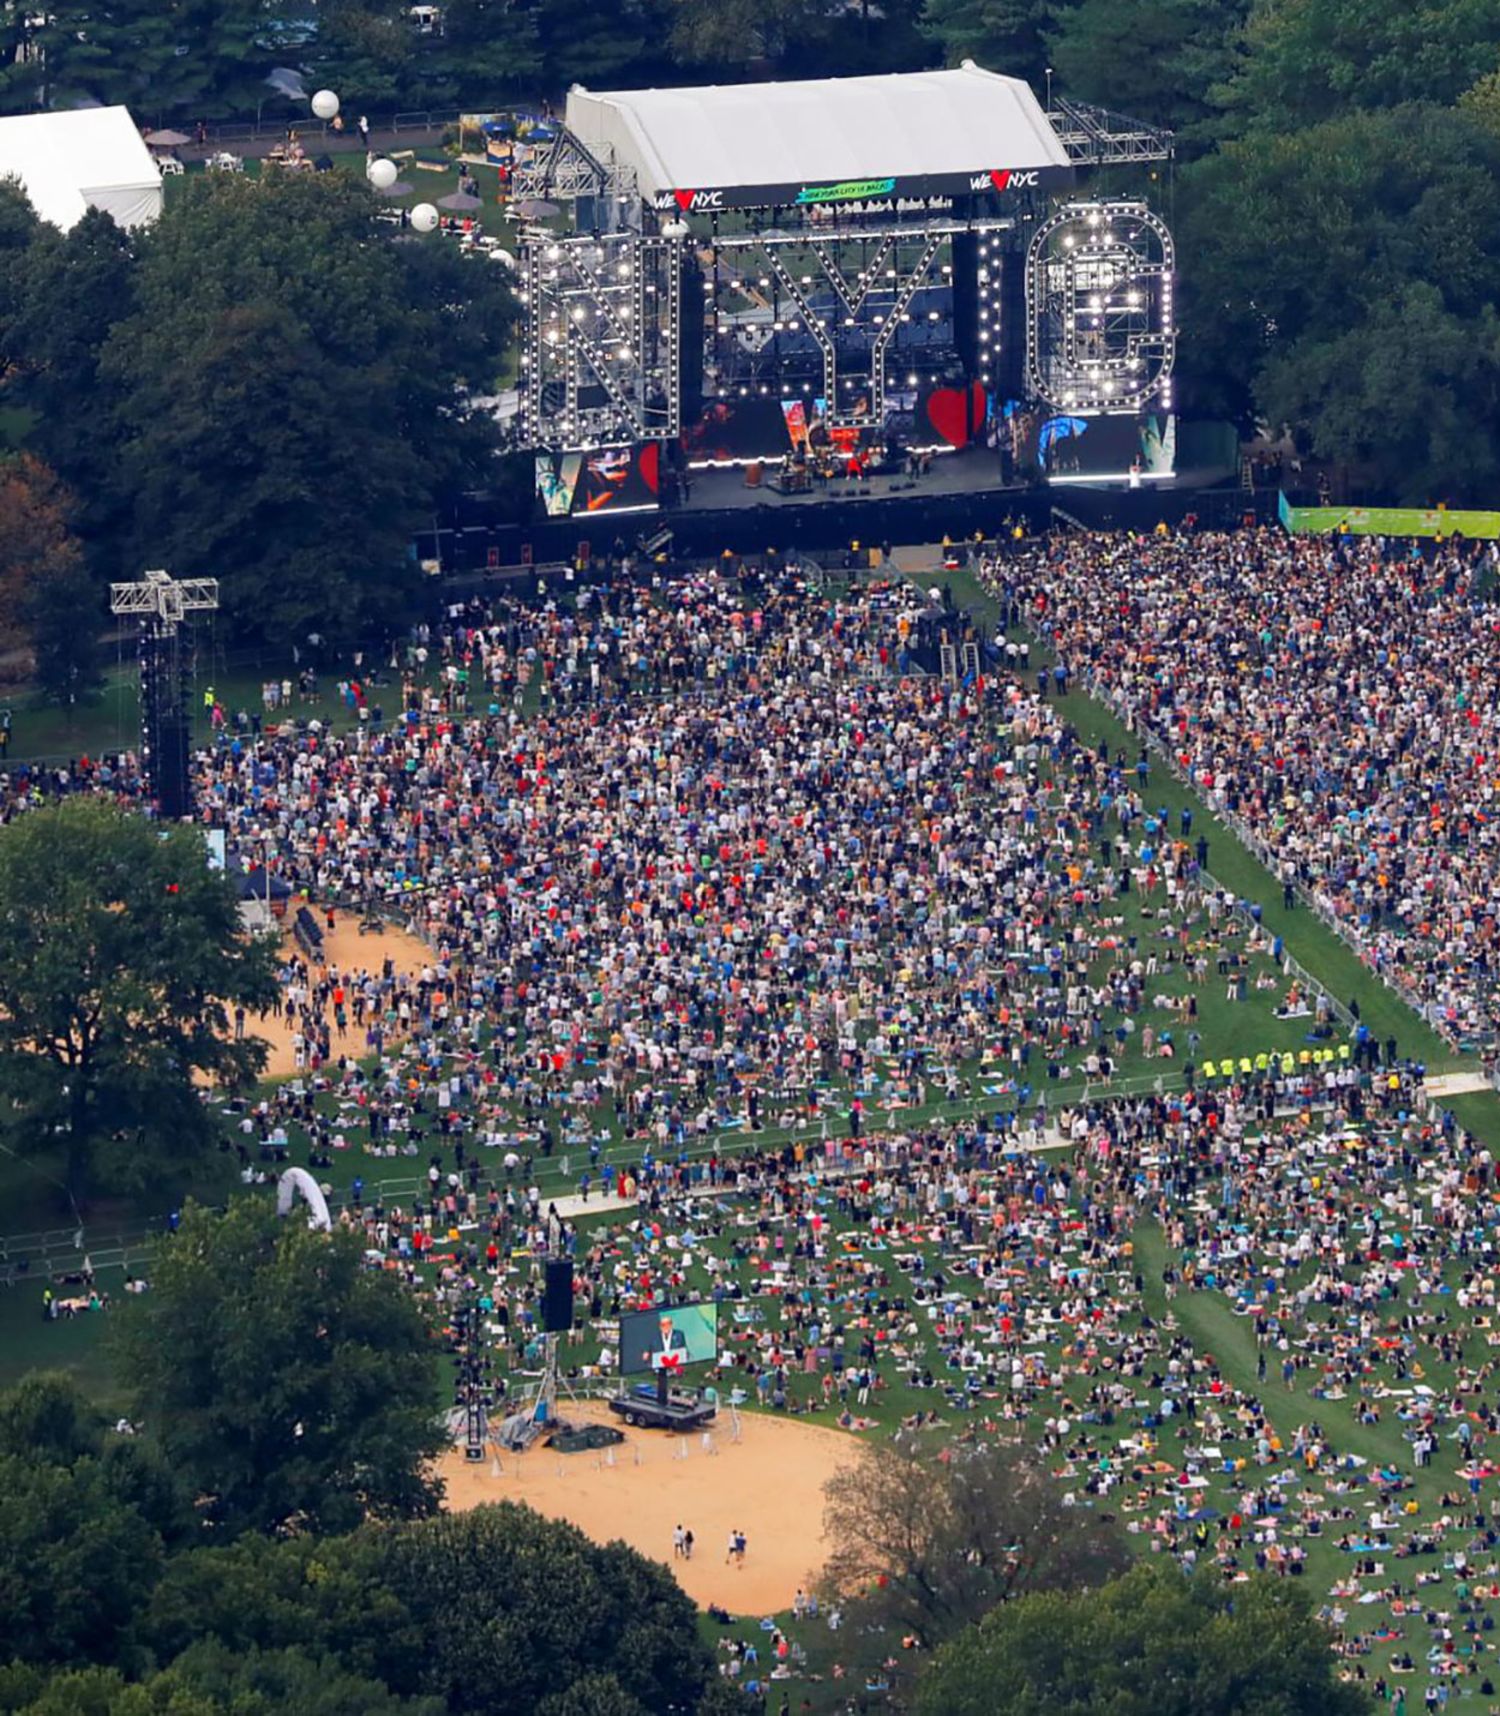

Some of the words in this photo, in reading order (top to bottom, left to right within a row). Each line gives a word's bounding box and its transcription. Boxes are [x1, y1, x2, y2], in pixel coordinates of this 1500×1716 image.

[970, 174, 992, 191] WE
[1006, 171, 1039, 188] NYC
[653, 192, 676, 209] WE
[690, 191, 723, 209] NYC
